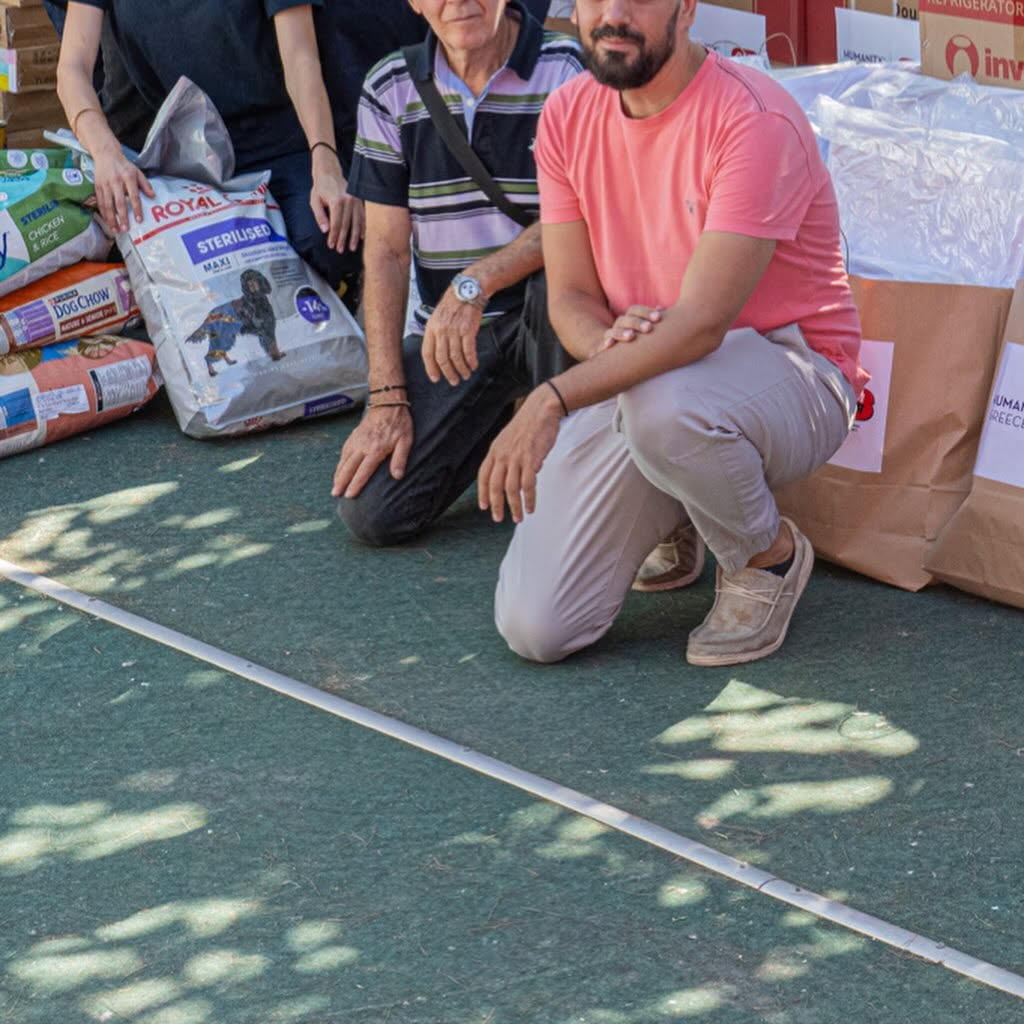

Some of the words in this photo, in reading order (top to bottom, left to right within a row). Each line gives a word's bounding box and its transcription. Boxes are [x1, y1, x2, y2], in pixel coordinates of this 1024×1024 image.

[151, 195, 222, 223] ROYAL
[28, 215, 65, 241] CHICKEN
[40, 232, 60, 247] RICE
[196, 223, 272, 255] STERILISED
[203, 256, 231, 273] MAXI
